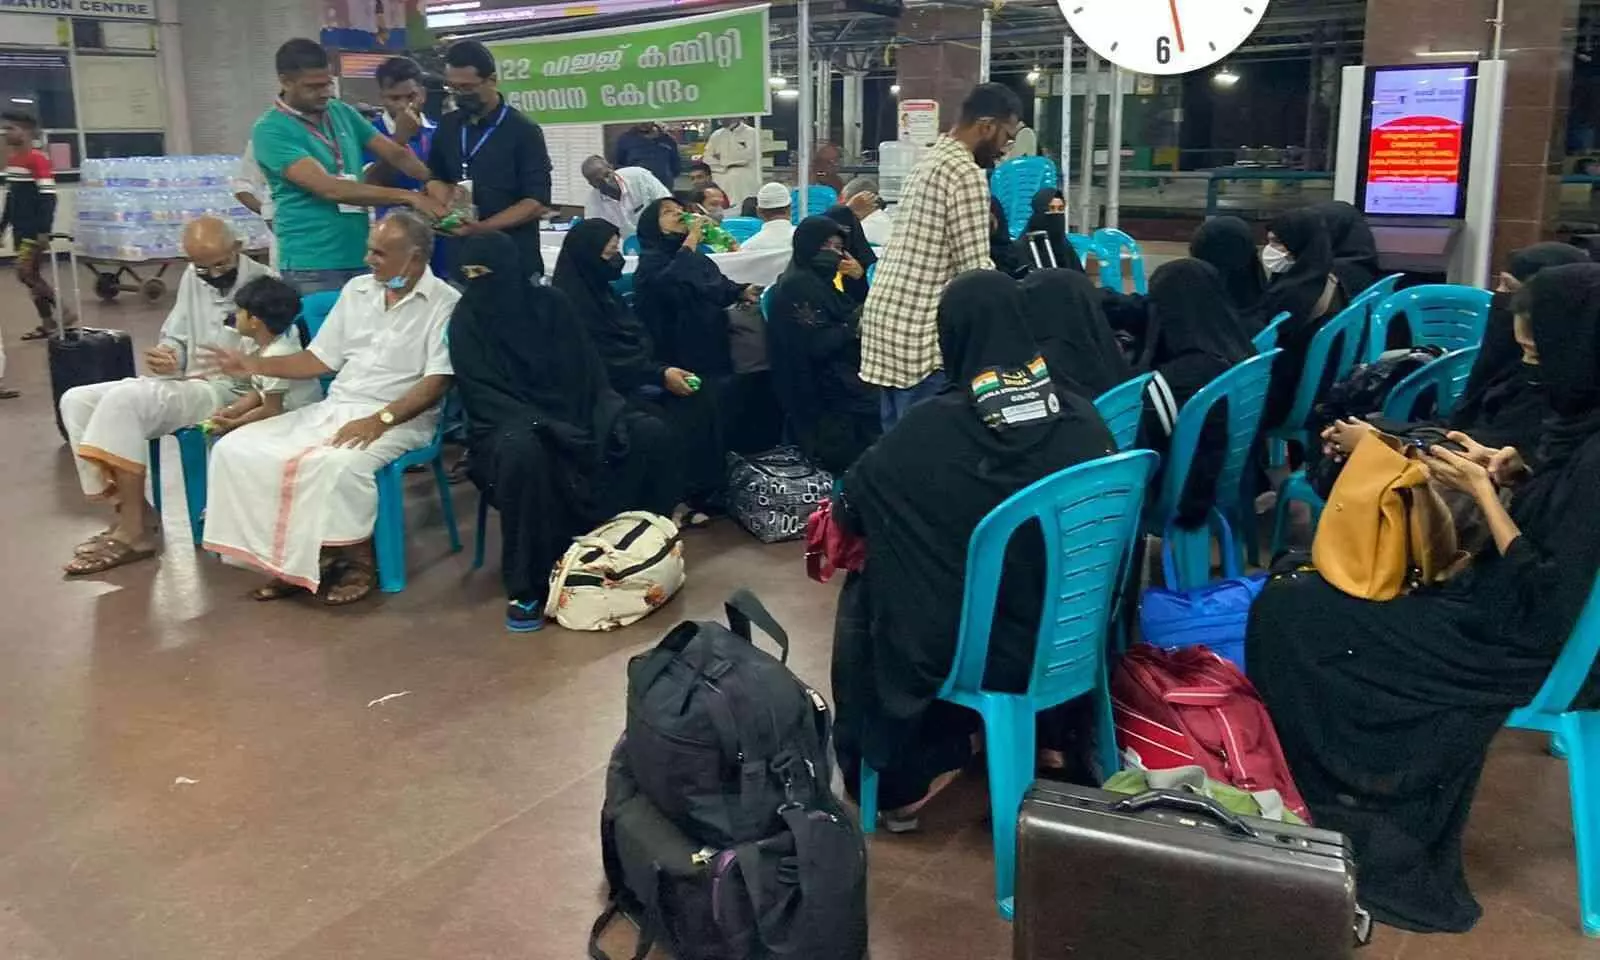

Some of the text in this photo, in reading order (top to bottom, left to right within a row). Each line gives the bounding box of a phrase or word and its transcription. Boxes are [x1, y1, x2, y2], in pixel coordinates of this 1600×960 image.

[80, 1, 148, 14] CENTRE
[638, 28, 742, 69] കമ്മിറ്റി
[1156, 36, 1170, 64] 6
[600, 79, 699, 109] കേന്ദ്രം
